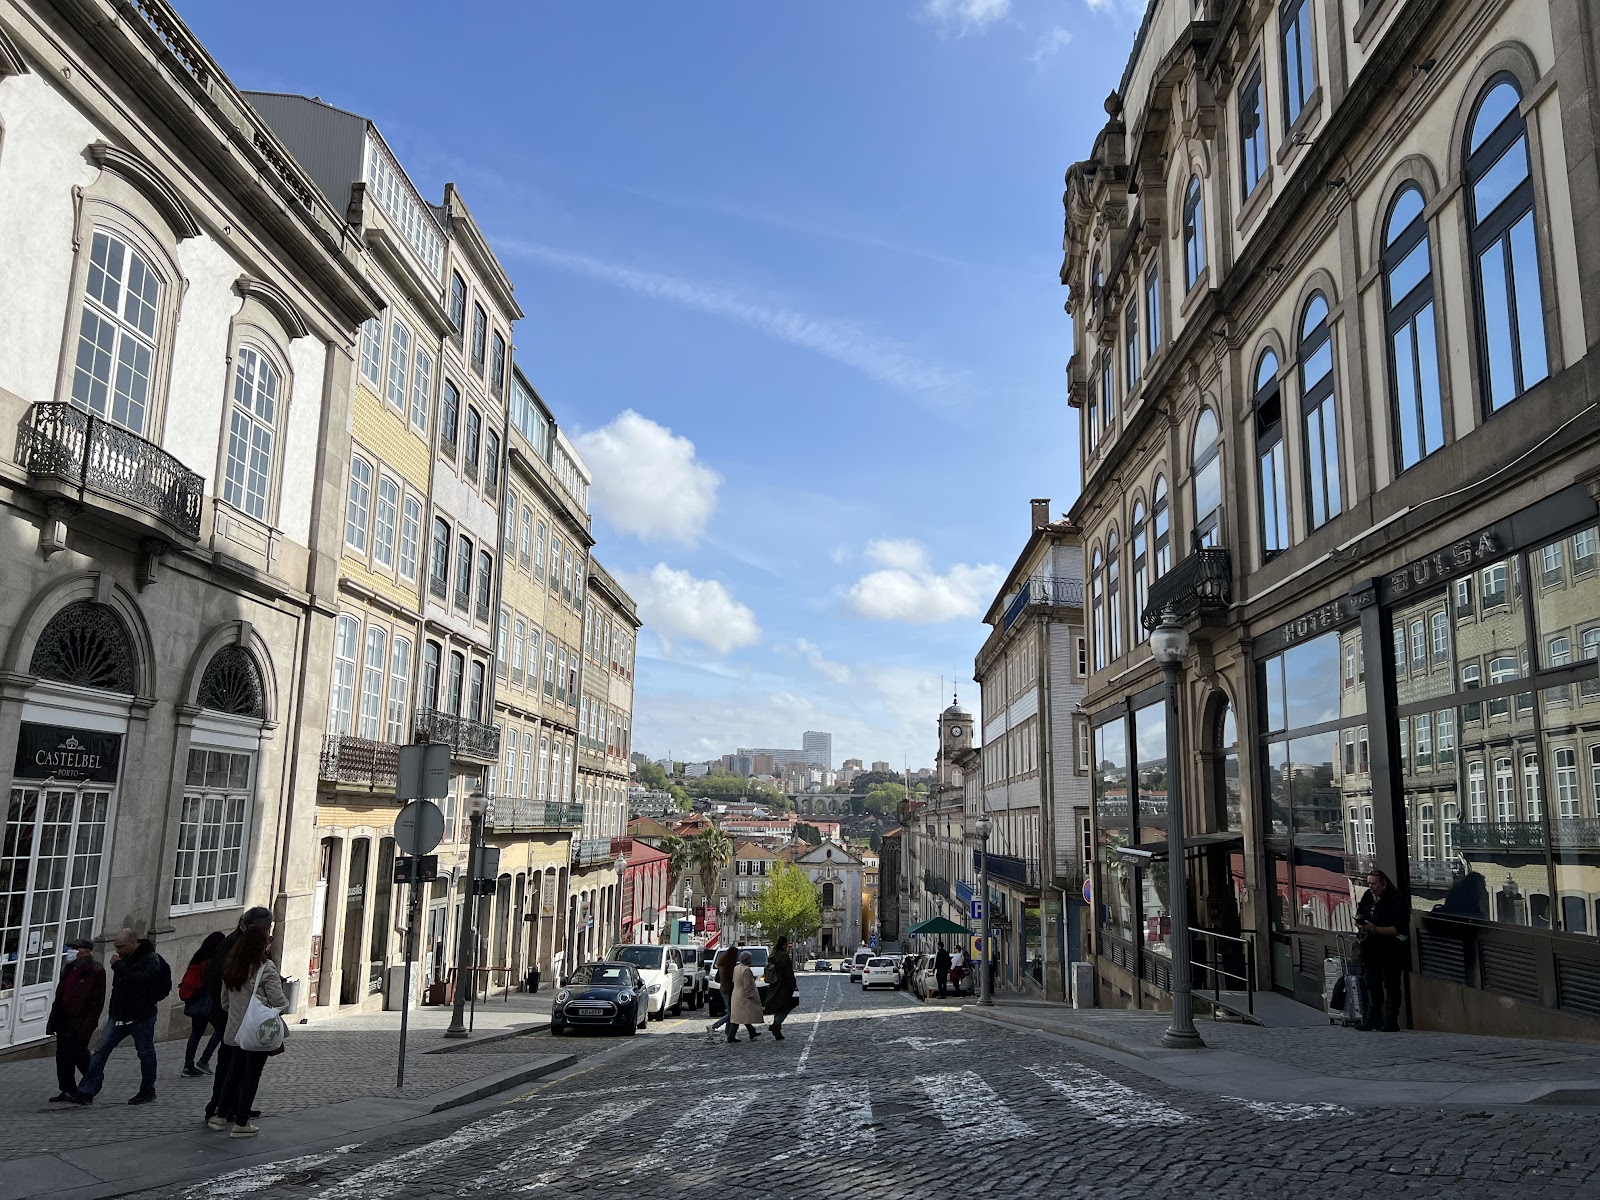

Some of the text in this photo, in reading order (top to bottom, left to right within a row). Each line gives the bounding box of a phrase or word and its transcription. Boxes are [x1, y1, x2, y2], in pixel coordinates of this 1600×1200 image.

[1283, 602, 1344, 642] HOTEL
[1391, 531, 1496, 593] BOLSA
[35, 749, 102, 769] CASTELBEL
[58, 769, 79, 777] PORTO
